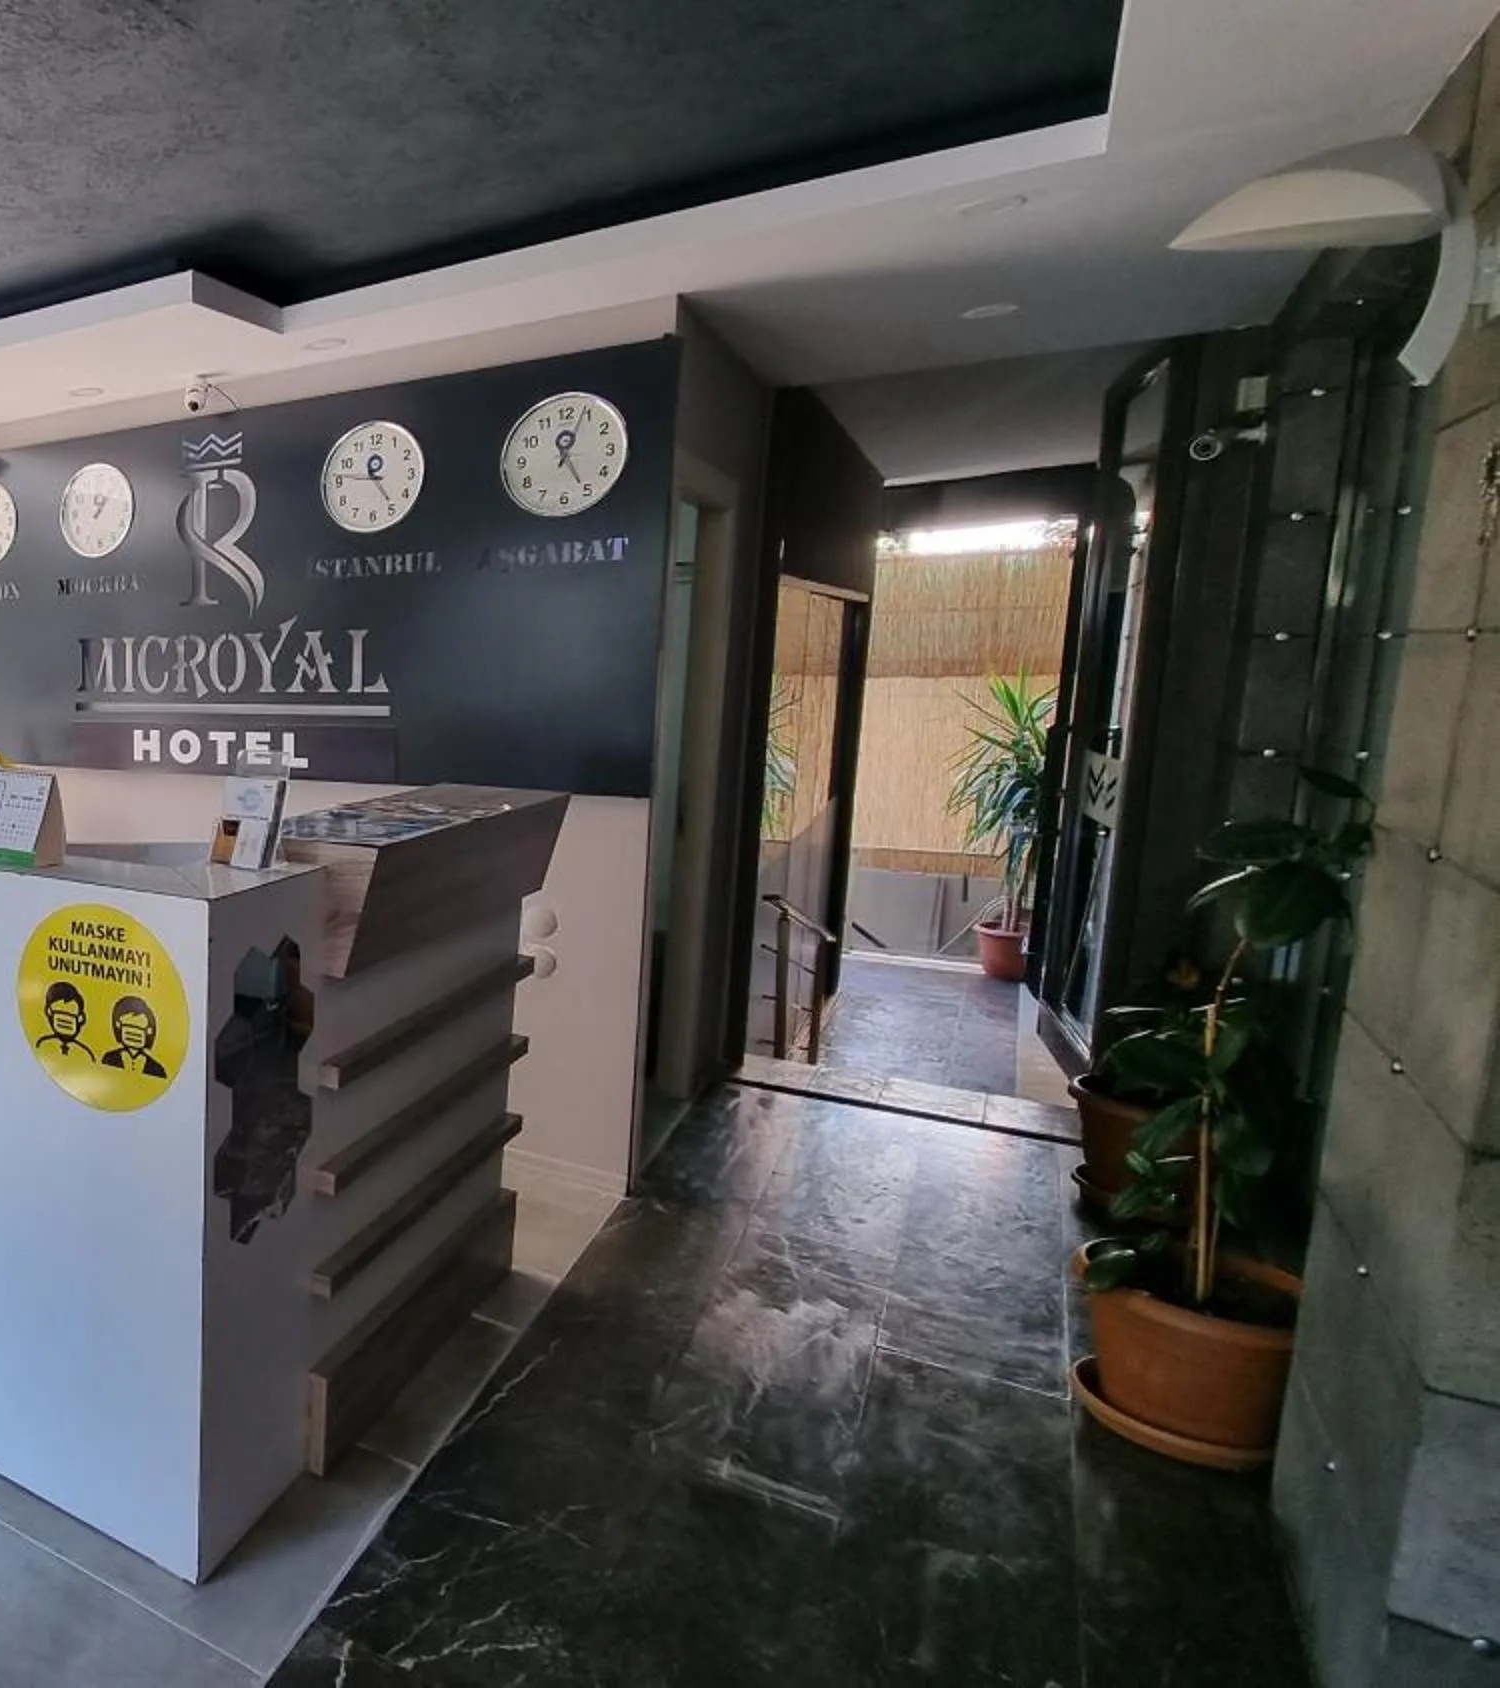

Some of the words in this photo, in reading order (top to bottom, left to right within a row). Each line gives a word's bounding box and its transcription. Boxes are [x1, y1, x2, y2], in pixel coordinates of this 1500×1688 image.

[559, 407, 574, 420] 12
[586, 409, 591, 421] 1
[538, 418, 550, 430] 11
[600, 422, 608, 434] 2
[370, 434, 382, 446] 12
[391, 437, 397, 448] 1
[524, 436, 538, 448] 10
[353, 441, 363, 453] 11
[606, 443, 615, 456] 3
[404, 449, 411, 461] 2
[341, 458, 353, 469] 10
[517, 456, 526, 469] 9
[408, 468, 415, 480] 3
[599, 465, 607, 477] 4
[336, 476, 343, 488] 9
[523, 476, 532, 488] 8
[402, 488, 409, 499] 4
[539, 489, 546, 501] 7
[583, 484, 592, 496] 5
[340, 496, 347, 506] 8
[560, 492, 568, 504] 6
[352, 507, 359, 518] 7
[369, 510, 376, 522] 6
[388, 504, 396, 516] 5
[77, 614, 389, 698] MICROYAL
[133, 729, 308, 768] HOTEL
[71, 921, 126, 942] MASKE
[48, 936, 151, 968] KULLANMAYI
[48, 956, 143, 986] UNUTMAYIN
